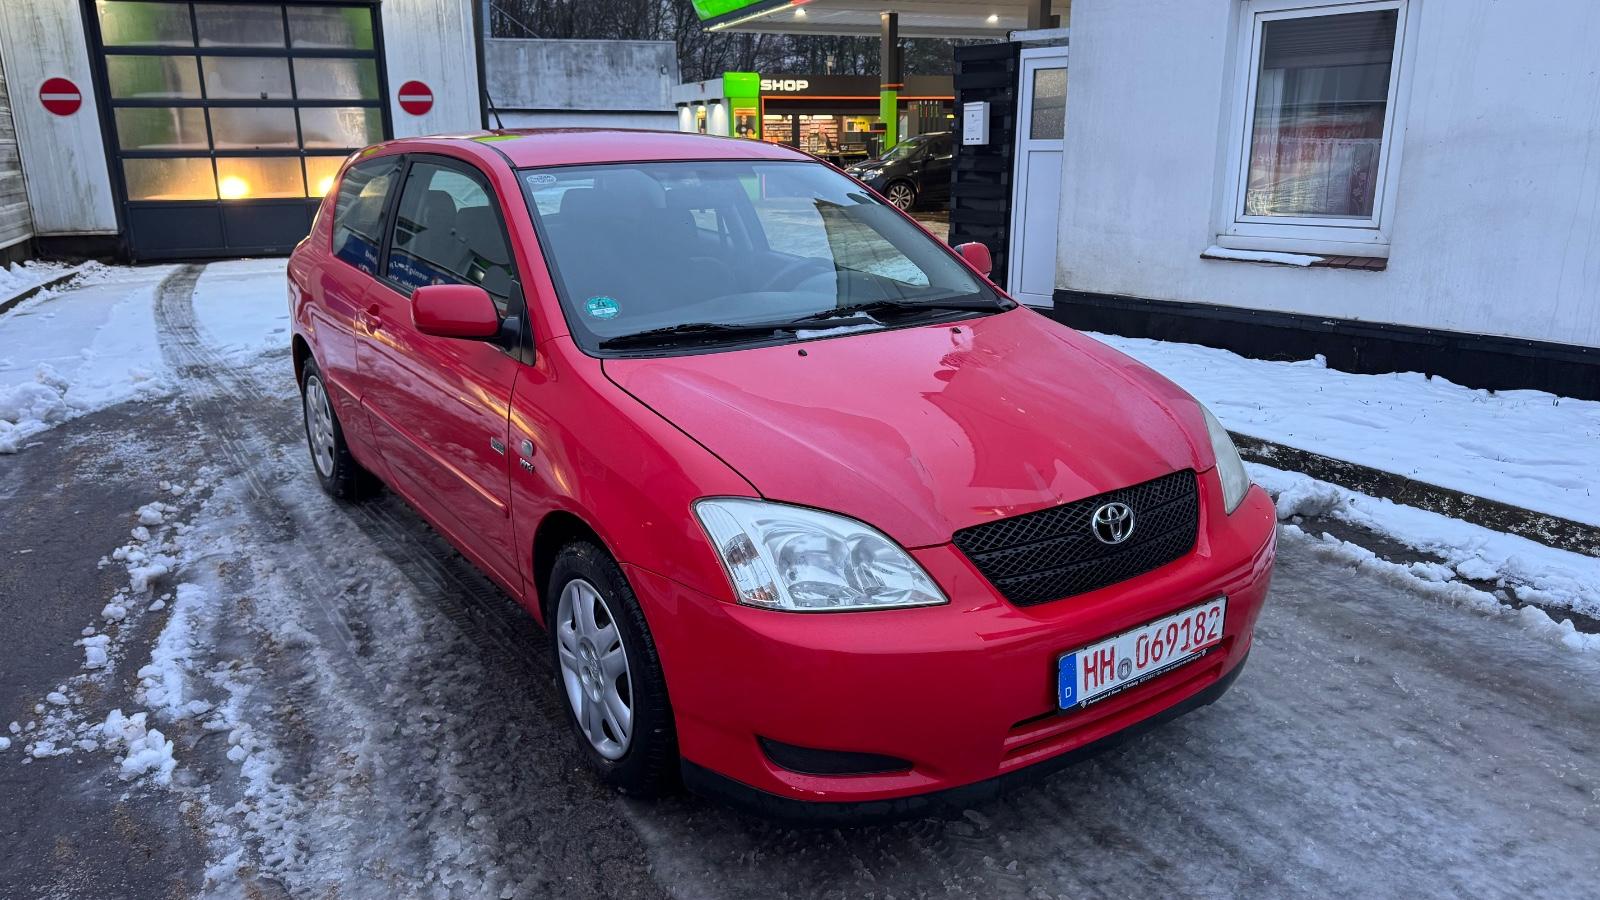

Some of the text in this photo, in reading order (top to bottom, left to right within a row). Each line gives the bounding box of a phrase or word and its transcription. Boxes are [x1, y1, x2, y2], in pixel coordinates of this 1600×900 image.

[760, 79, 809, 91] SHOP
[1083, 606, 1221, 692] HH 069182
[1065, 686, 1072, 698] D
